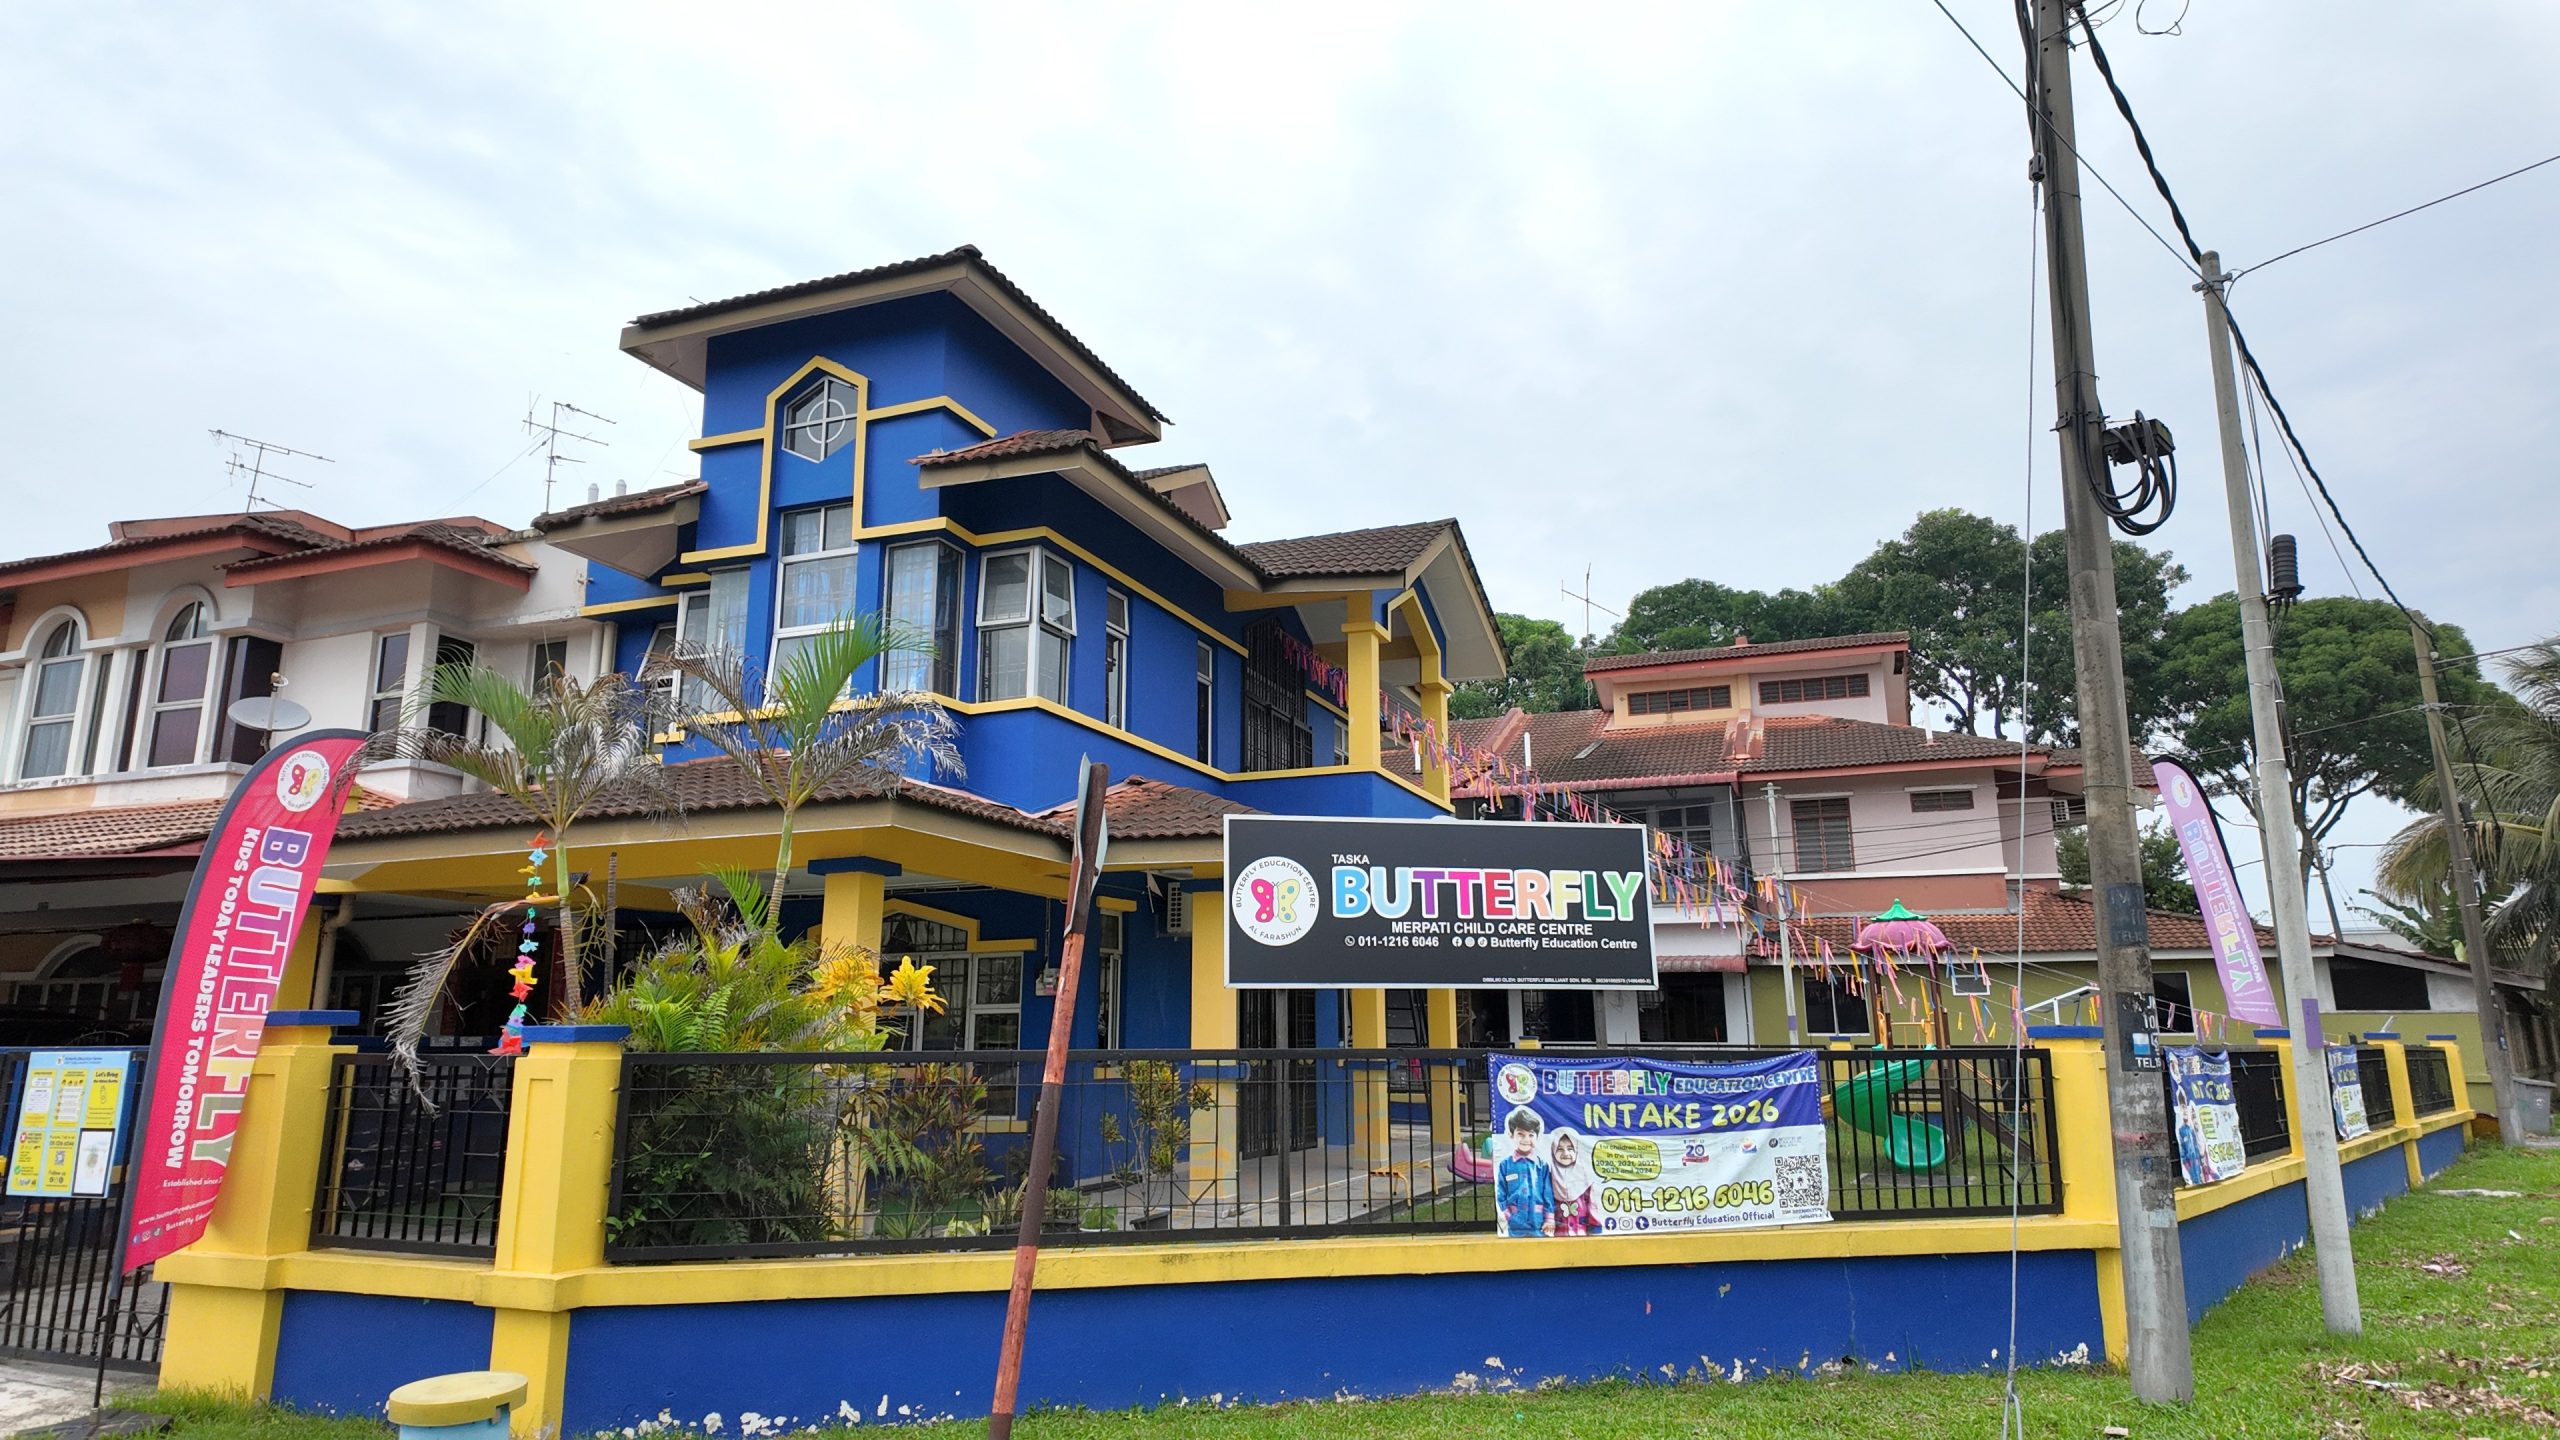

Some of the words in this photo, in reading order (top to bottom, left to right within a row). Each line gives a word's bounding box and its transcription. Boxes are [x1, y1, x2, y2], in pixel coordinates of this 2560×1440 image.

[234, 827, 261, 871] KIDS
[1331, 853, 1370, 864] TASKA
[1235, 865, 1257, 907] BUTTERFLY
[1259, 860, 1303, 876] EDUCATION
[1302, 876, 1316, 908] CENTRE
[1331, 865, 1644, 922] BUTTERFLY
[212, 875, 244, 943] TODAY
[1248, 925, 1258, 934] AL
[1260, 926, 1302, 941] FARASHUN
[1358, 935, 1409, 947] 011-1216
[1411, 935, 1439, 947] 6046
[1391, 921, 1450, 934] MERPATI
[1453, 922, 1495, 934] CHILD
[1497, 922, 1536, 935] CARE
[1539, 923, 1593, 936] CENTRE
[1490, 937, 1539, 950] Butterfly
[1541, 937, 1598, 949] Education
[1600, 938, 1638, 949] Centre
[190, 943, 224, 1033] LEADERS
[190, 825, 312, 1168] BUTTERFLY
[1542, 1069, 1672, 1096] BUTTERFLY
[1674, 1074, 1765, 1094] EDUCATION
[1763, 1065, 1817, 1089] CENTRE
[166, 1036, 204, 1168] TOMORROW
[1584, 1101, 1701, 1129] INTAKE
[1711, 1098, 1779, 1127] 2026
[163, 1177, 203, 1187] Established
[1601, 1185, 1709, 1213] 011-1216
[1713, 1180, 1775, 1208] 6046
[1652, 1216, 1694, 1227] Butterfly
[1696, 1213, 1740, 1224] Education
[1742, 1210, 1775, 1221] Official
